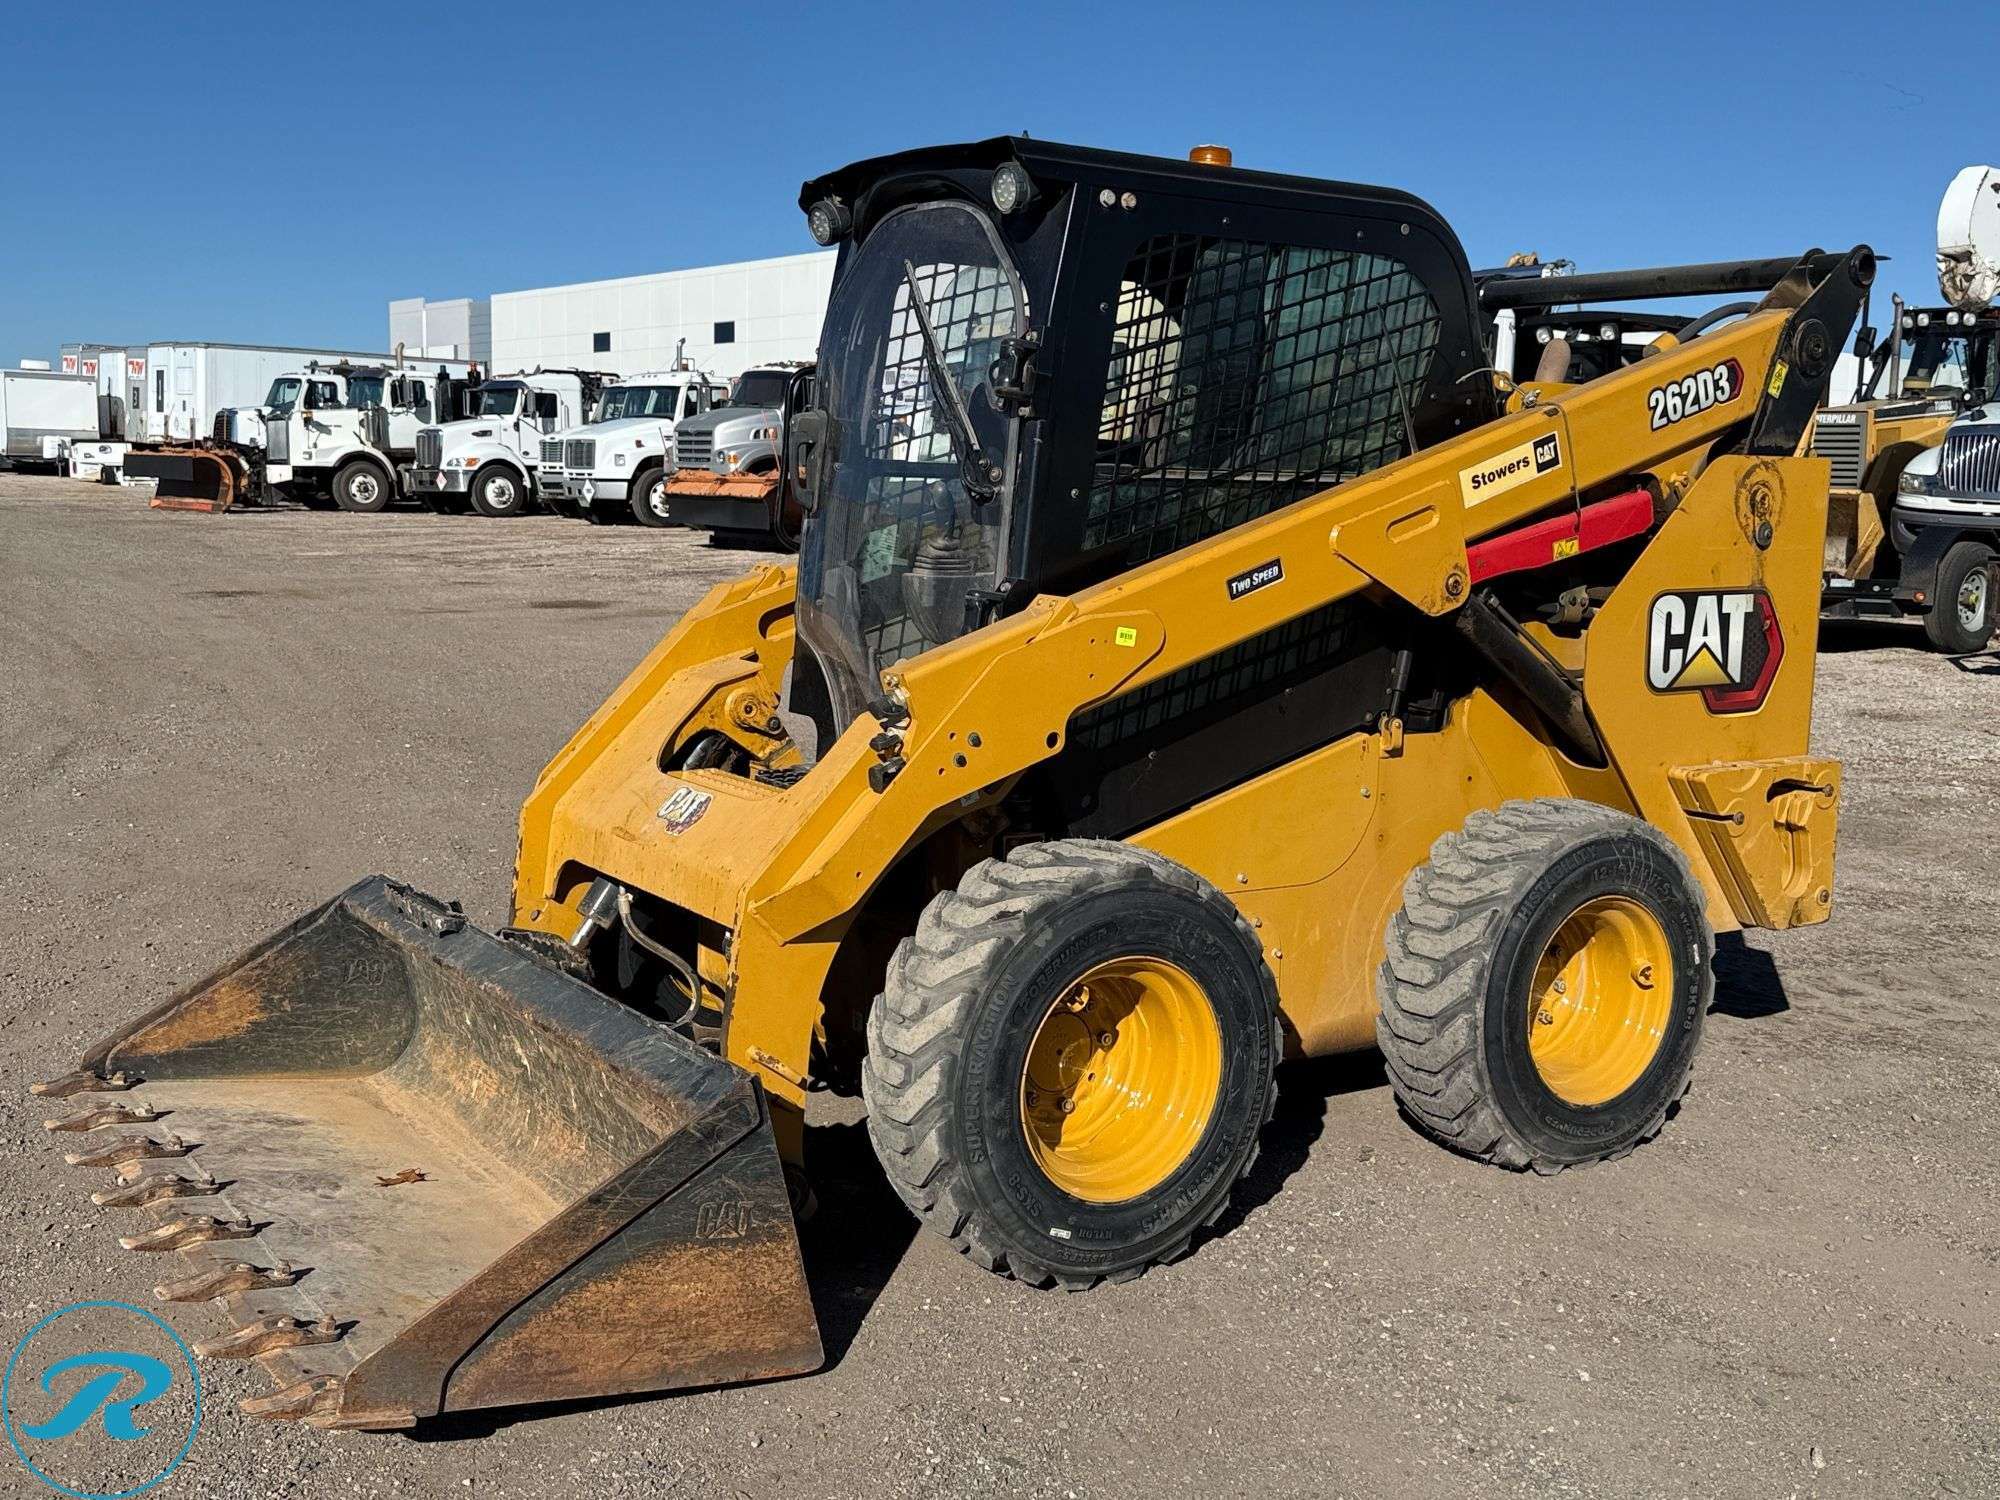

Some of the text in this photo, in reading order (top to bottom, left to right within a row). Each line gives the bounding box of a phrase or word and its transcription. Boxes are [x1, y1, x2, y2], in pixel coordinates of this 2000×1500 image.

[1649, 364, 1731, 430] 262D3
[1471, 441, 1556, 490] Stowers CAT
[1649, 593, 1754, 689] CAT
[658, 787, 709, 824] CAT
[696, 1201, 754, 1238] CAT
